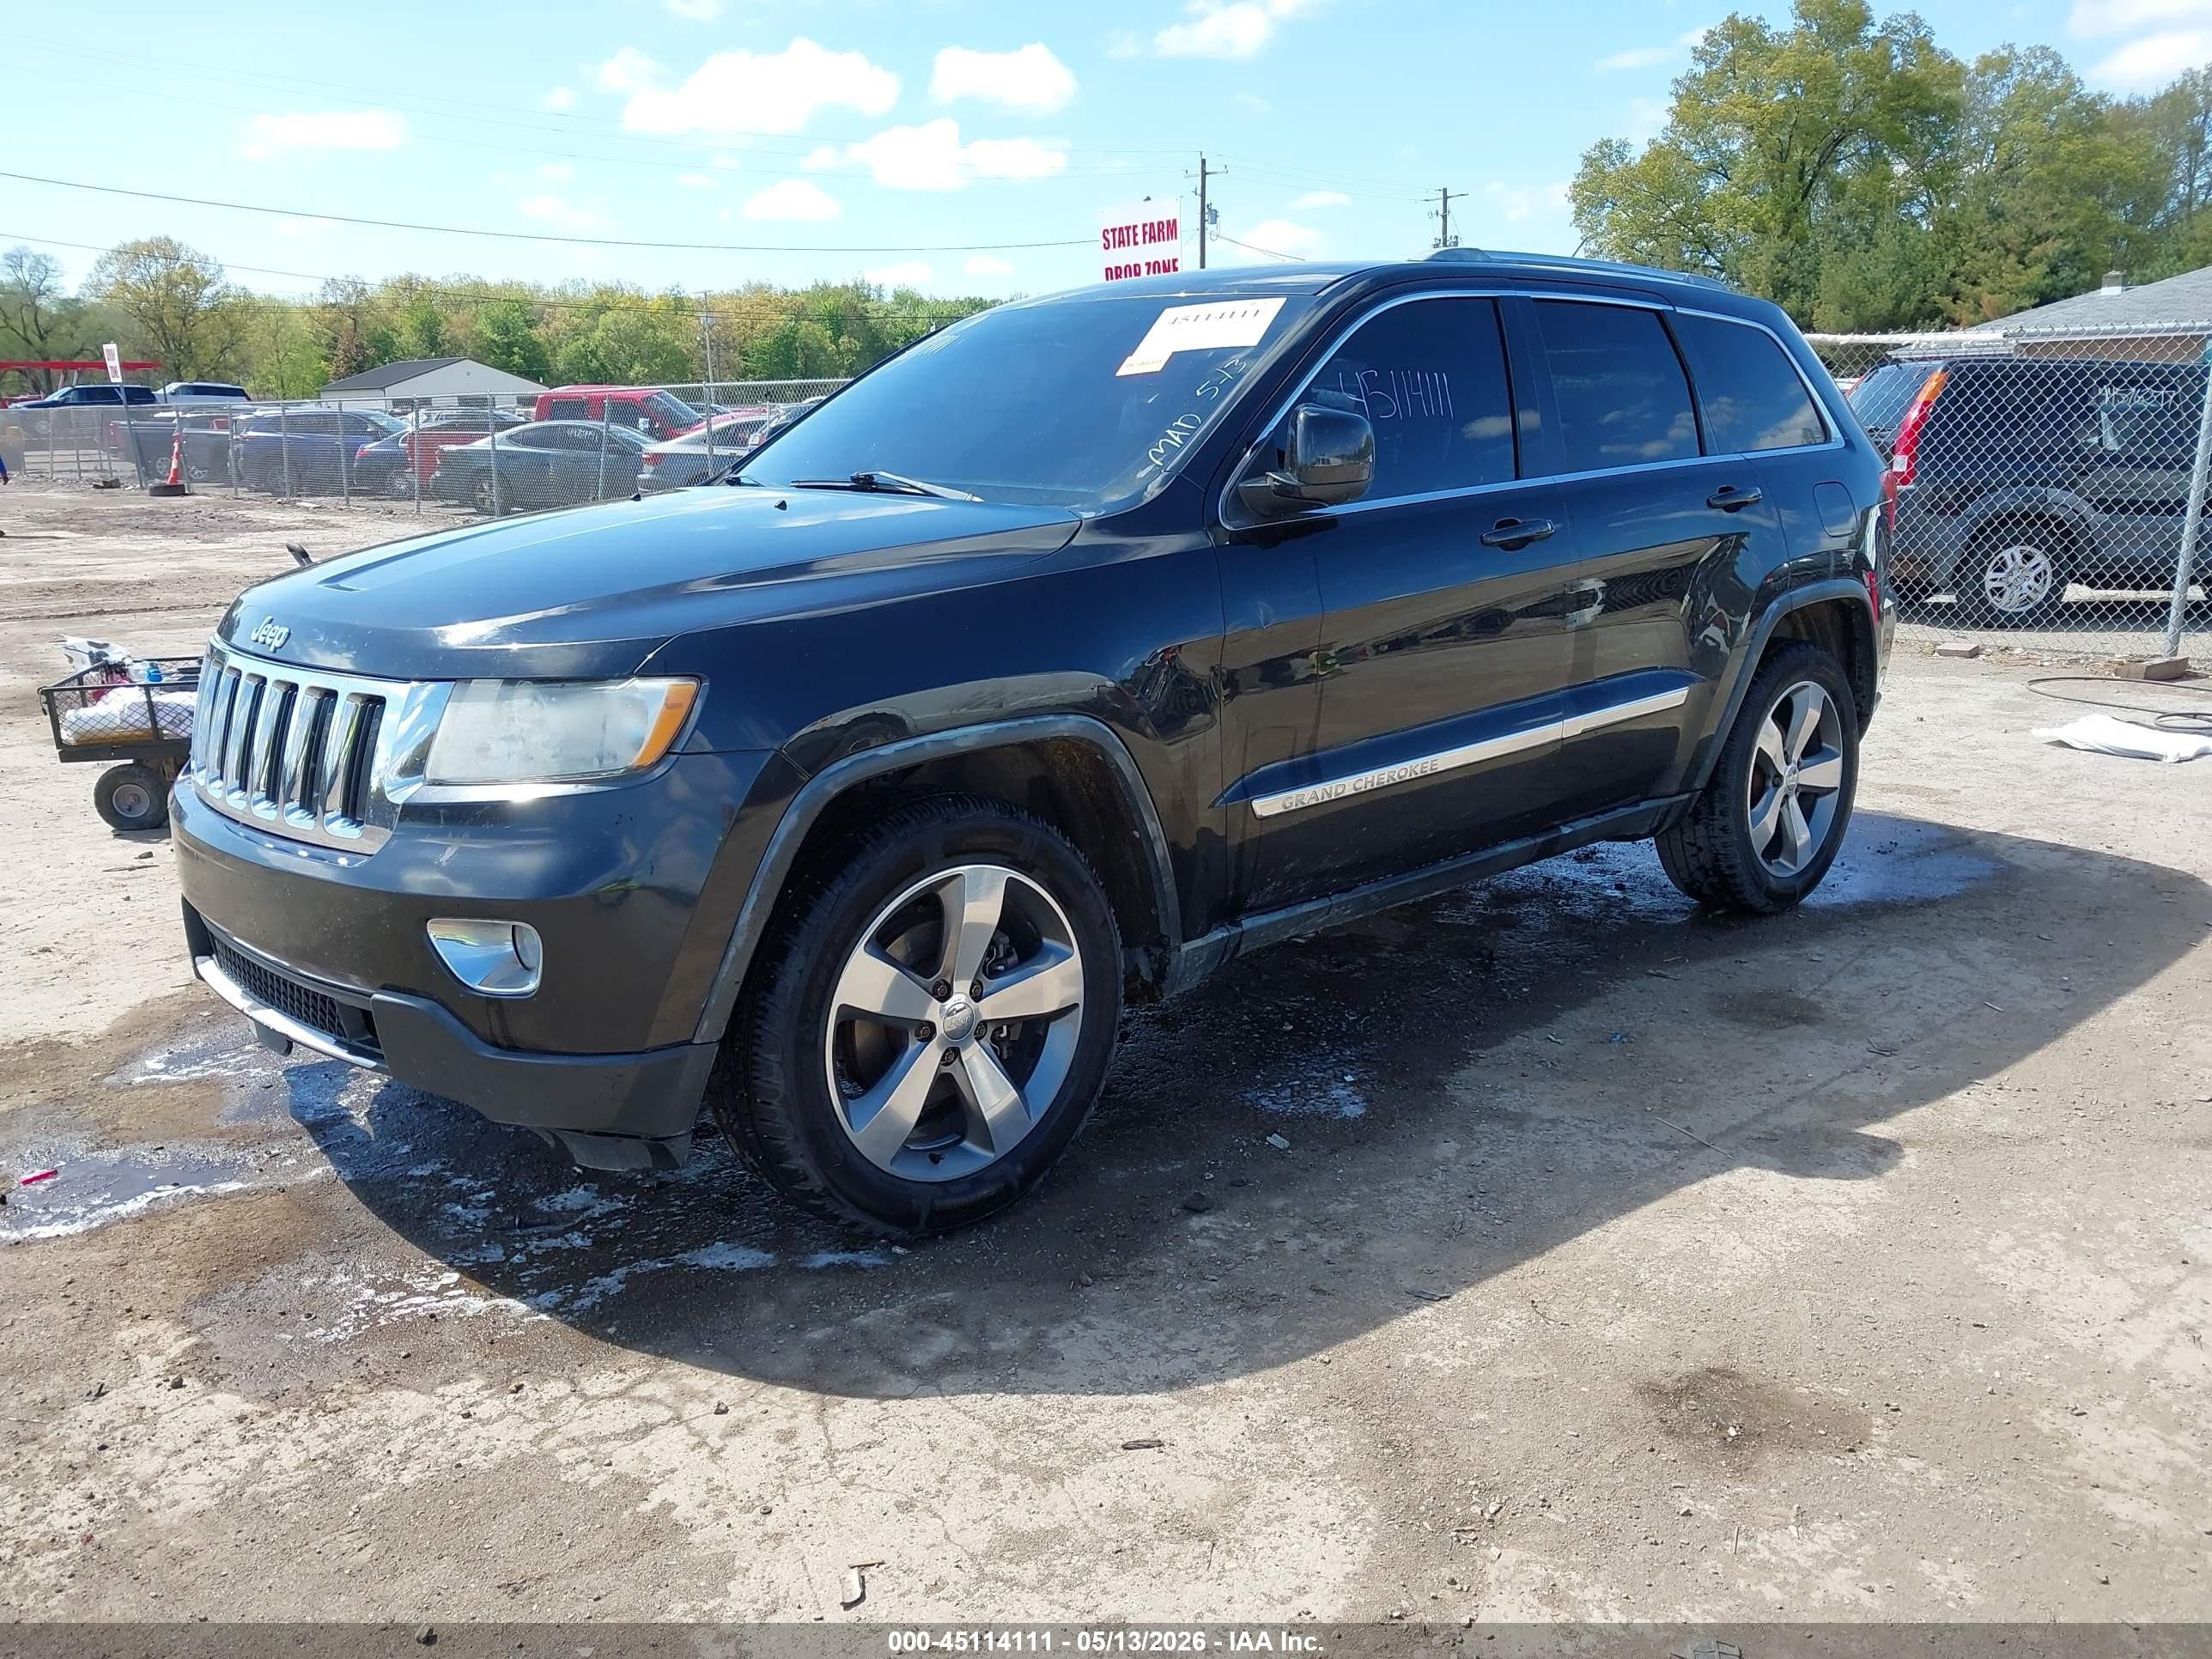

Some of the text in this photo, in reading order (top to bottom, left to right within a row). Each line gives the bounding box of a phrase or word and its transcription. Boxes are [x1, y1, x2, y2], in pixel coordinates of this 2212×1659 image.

[1102, 218, 1178, 250] STATE FARM
[1339, 369, 1454, 419] 45114111
[1148, 413, 1201, 466] MAD
[251, 615, 290, 653] Jeep
[1281, 758, 1440, 810] GRAND CHEROKEE
